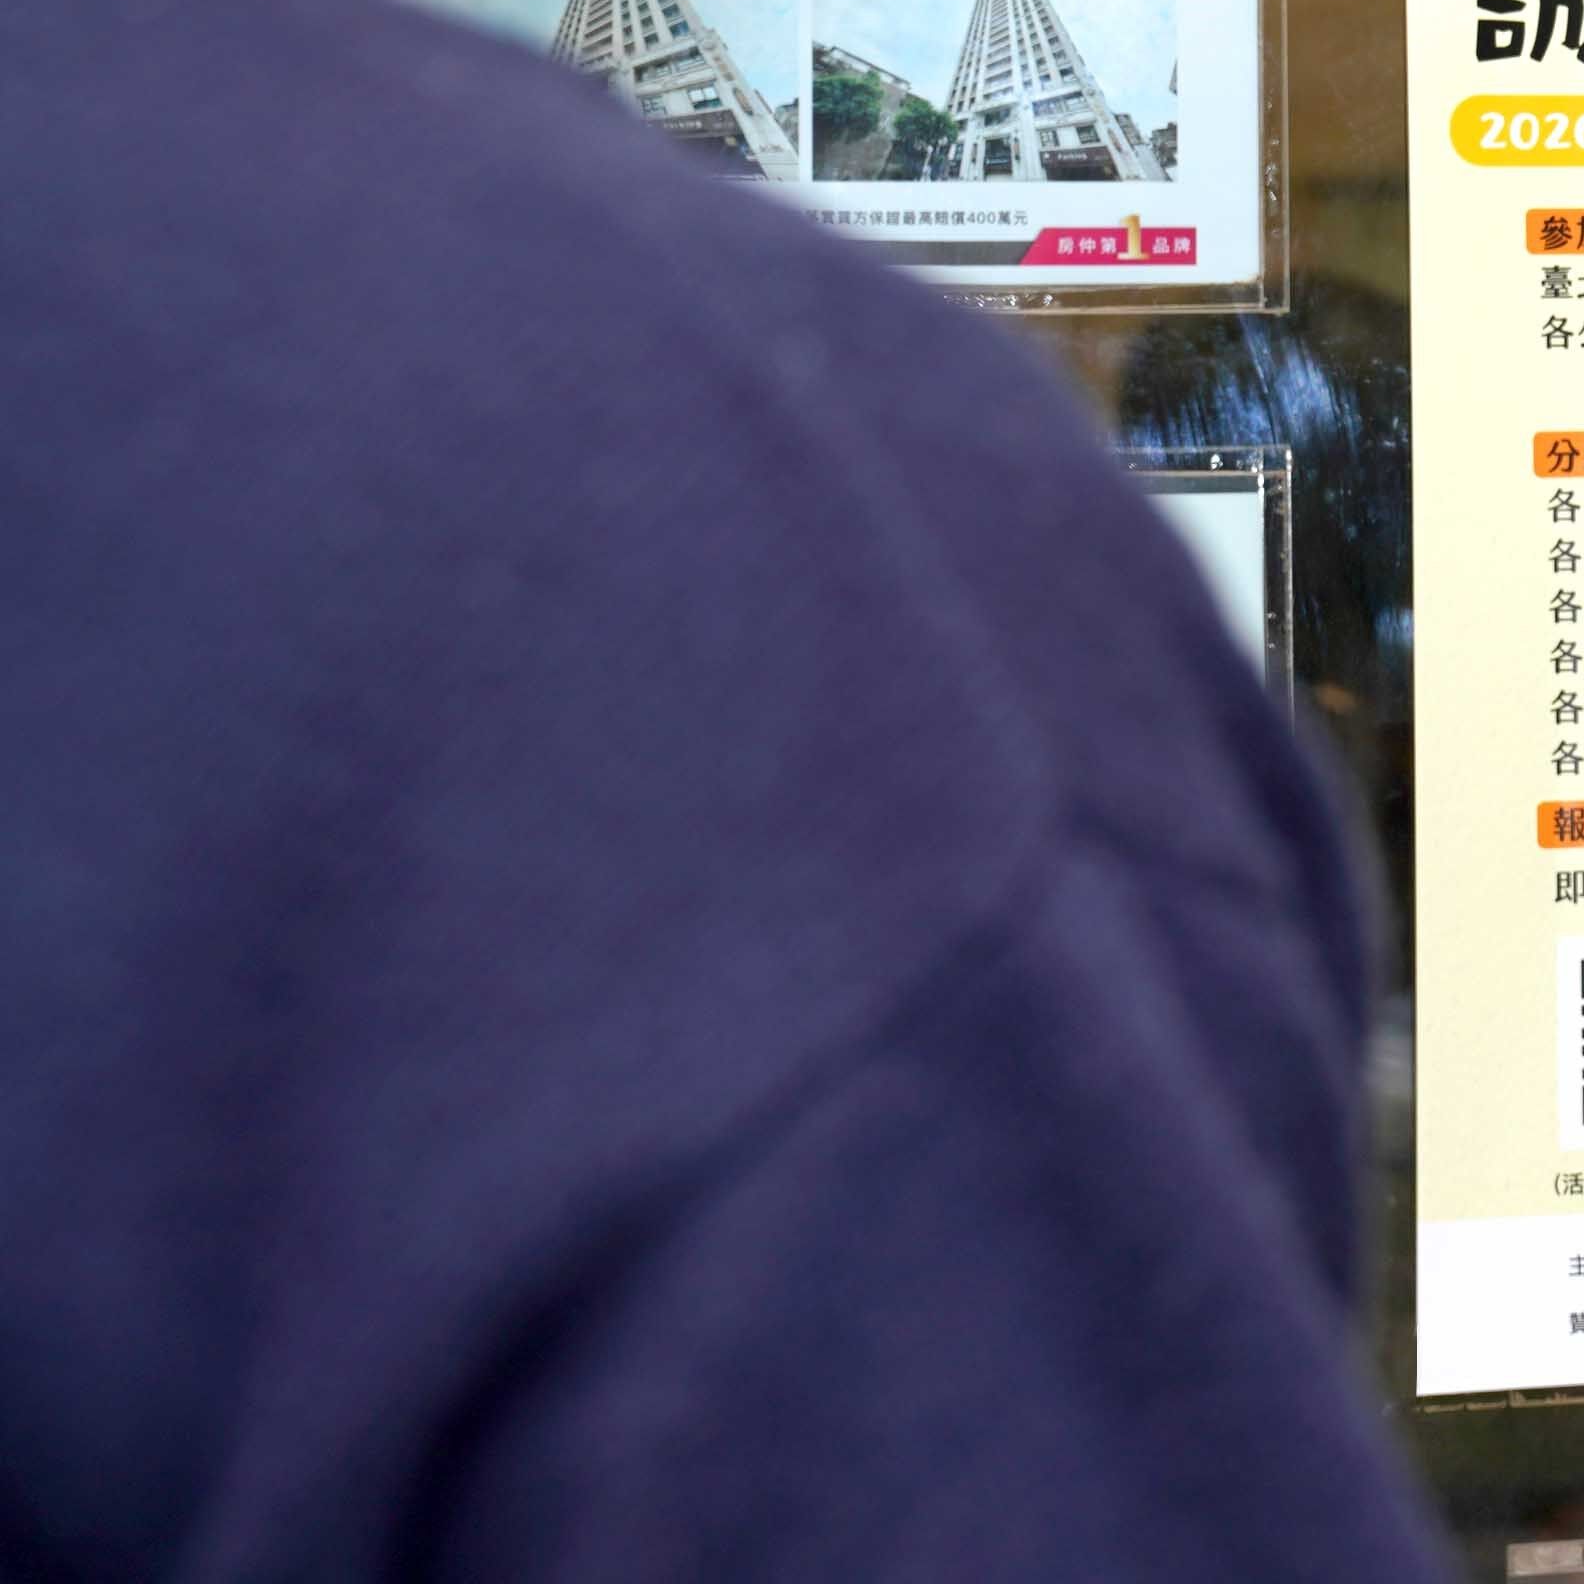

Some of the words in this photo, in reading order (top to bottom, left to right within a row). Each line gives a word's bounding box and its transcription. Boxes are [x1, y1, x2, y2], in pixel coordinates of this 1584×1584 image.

[1057, 214, 1190, 260] 房仲第1品牌
